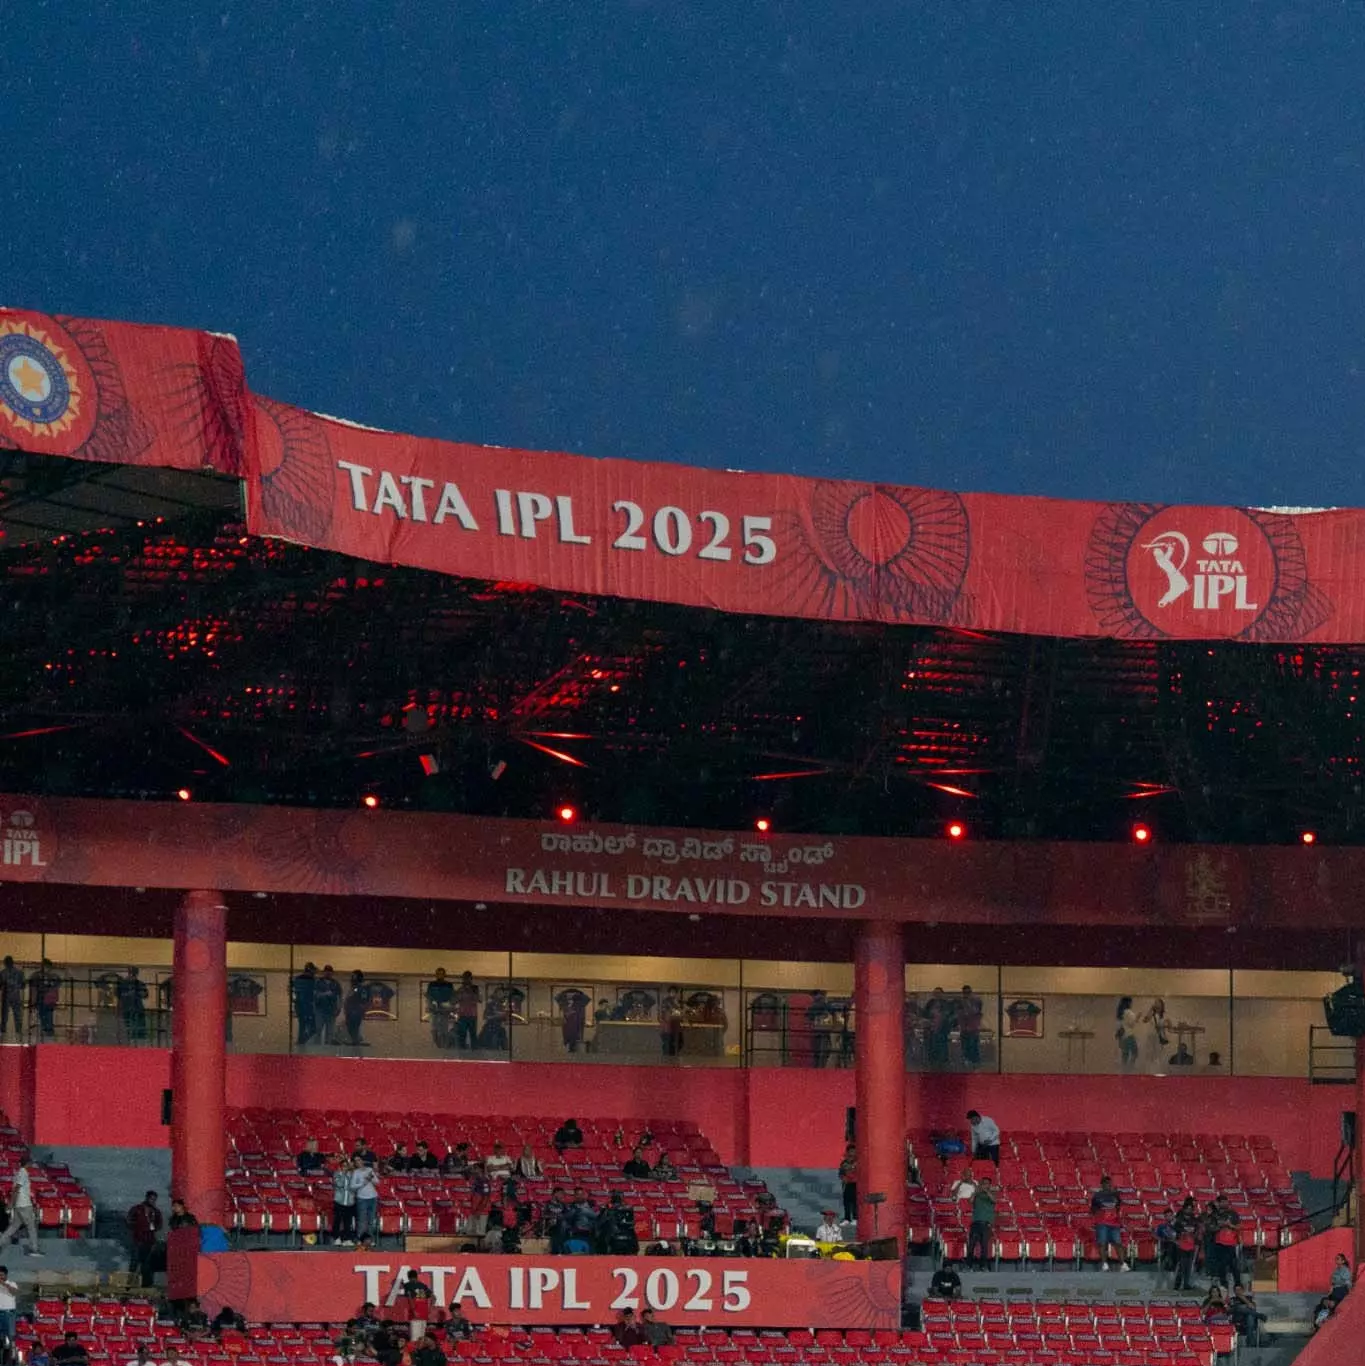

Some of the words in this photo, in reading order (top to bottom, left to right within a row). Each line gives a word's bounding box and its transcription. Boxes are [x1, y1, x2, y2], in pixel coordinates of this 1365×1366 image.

[338, 459, 480, 533] TATA
[494, 488, 592, 546] IPL
[611, 500, 778, 566] 2025
[1197, 560, 1245, 573] TATA
[1192, 575, 1258, 610] IPL
[5, 830, 38, 839] TATA
[2, 840, 46, 868] IPL
[505, 868, 616, 899] RAHUL
[626, 874, 750, 904] DRAVID
[760, 881, 866, 909] STAND
[354, 1264, 492, 1309] TATA
[510, 1267, 591, 1309] IPL
[610, 1267, 751, 1312] 2025
